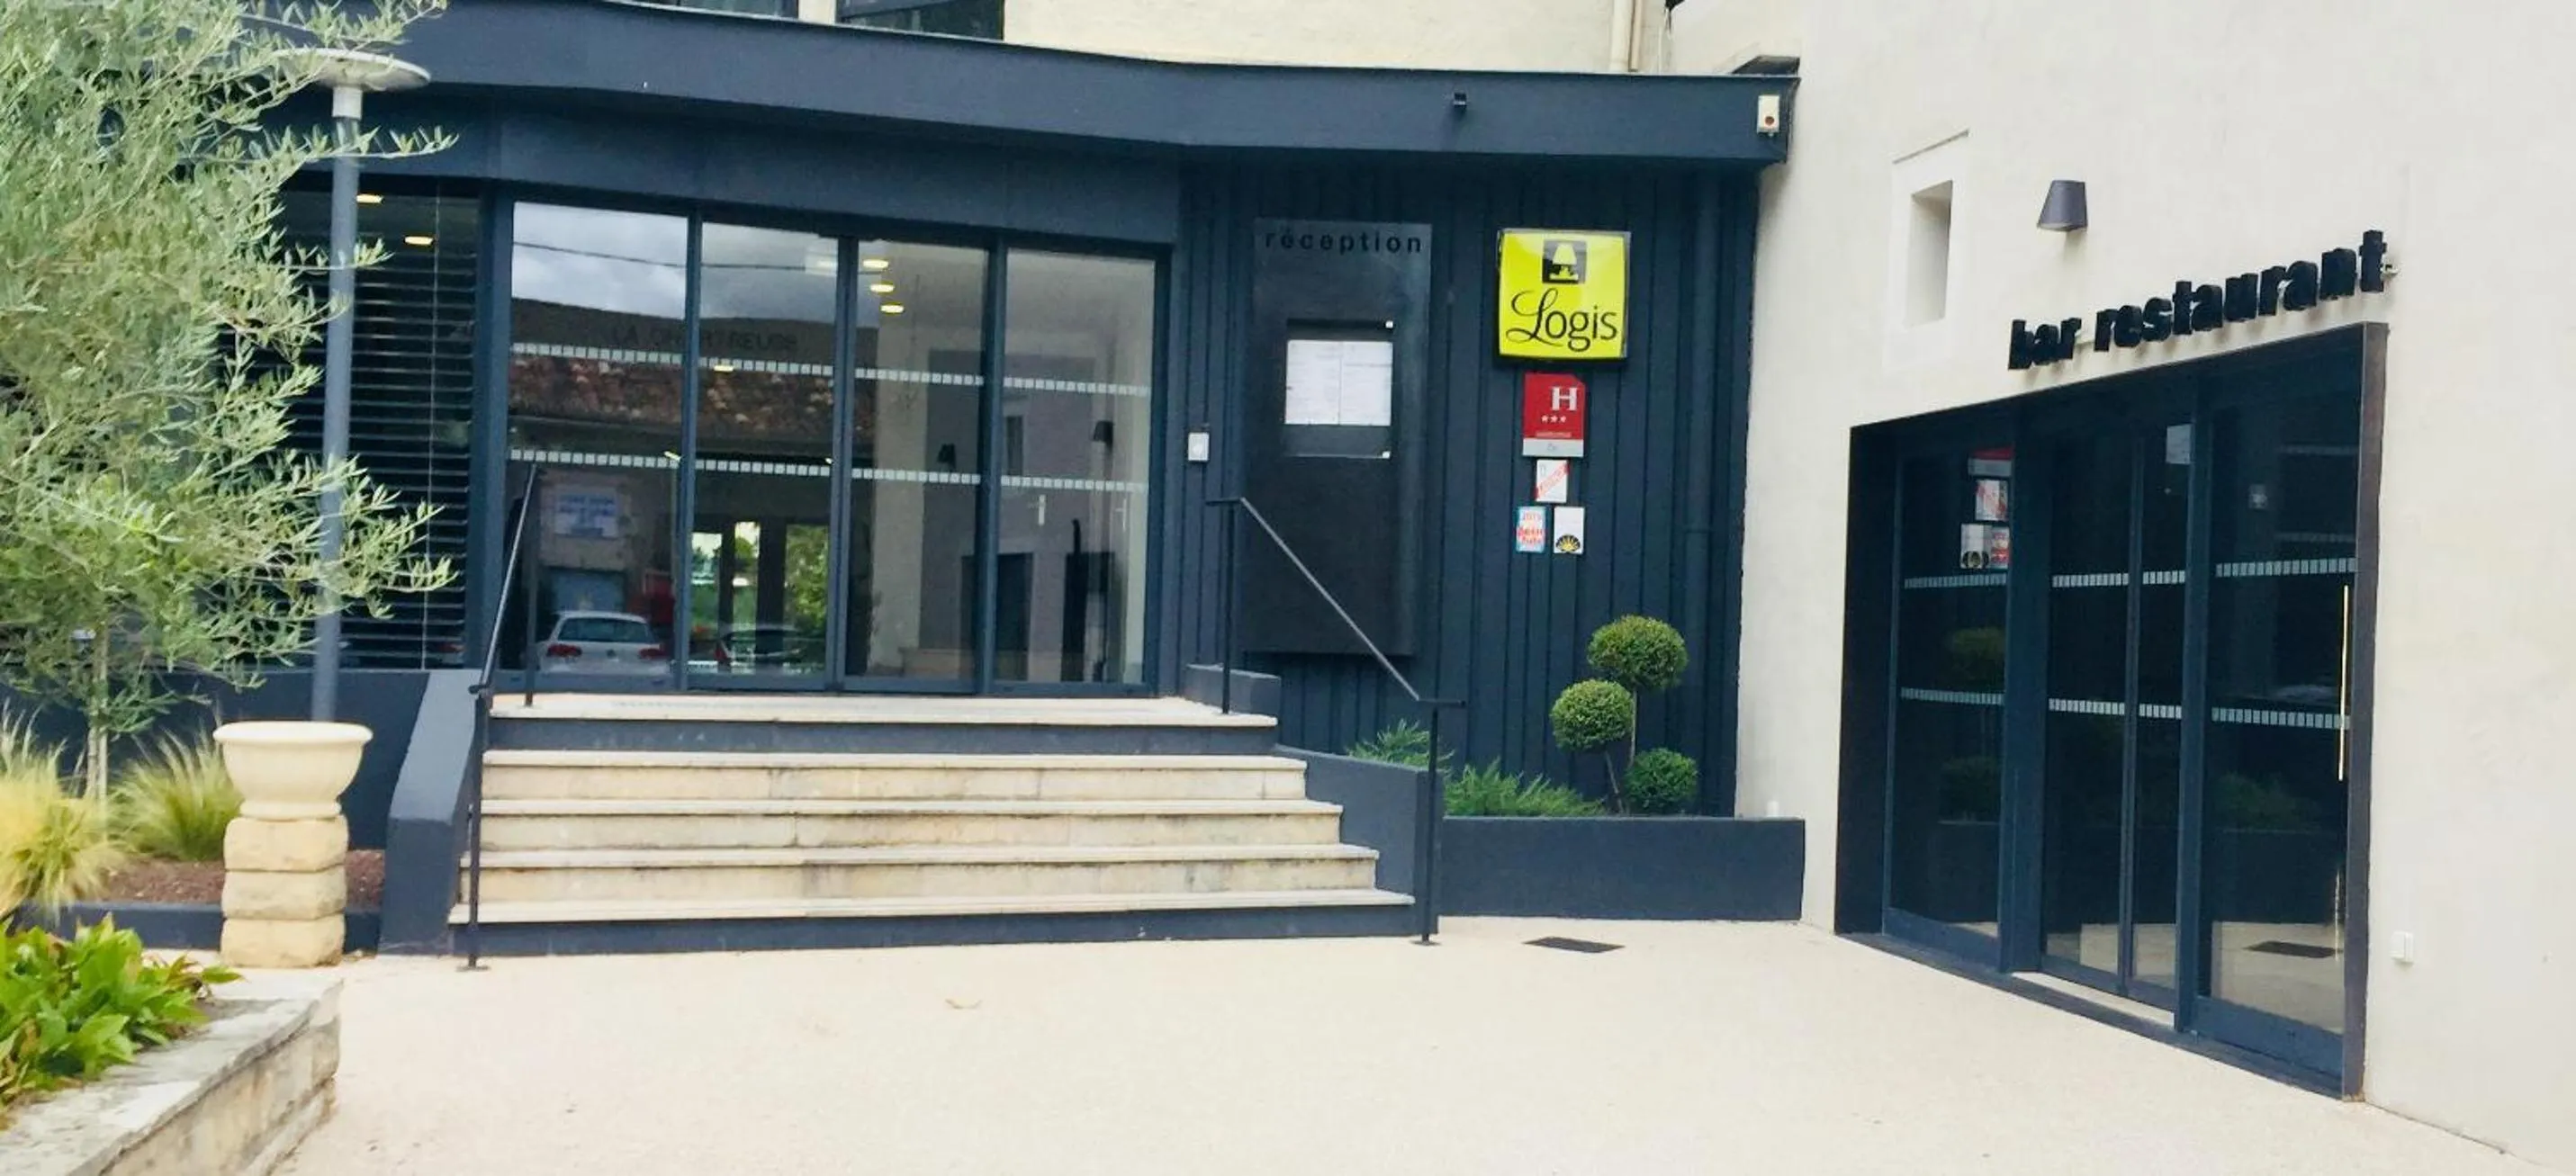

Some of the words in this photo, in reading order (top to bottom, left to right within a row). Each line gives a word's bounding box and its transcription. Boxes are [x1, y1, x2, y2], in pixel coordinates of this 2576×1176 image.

[1265, 228, 1422, 256] réception
[1506, 287, 1617, 353] Logis
[2007, 318, 2082, 370] bar
[2094, 229, 2387, 352] restaurant
[1550, 386, 1579, 411] H
